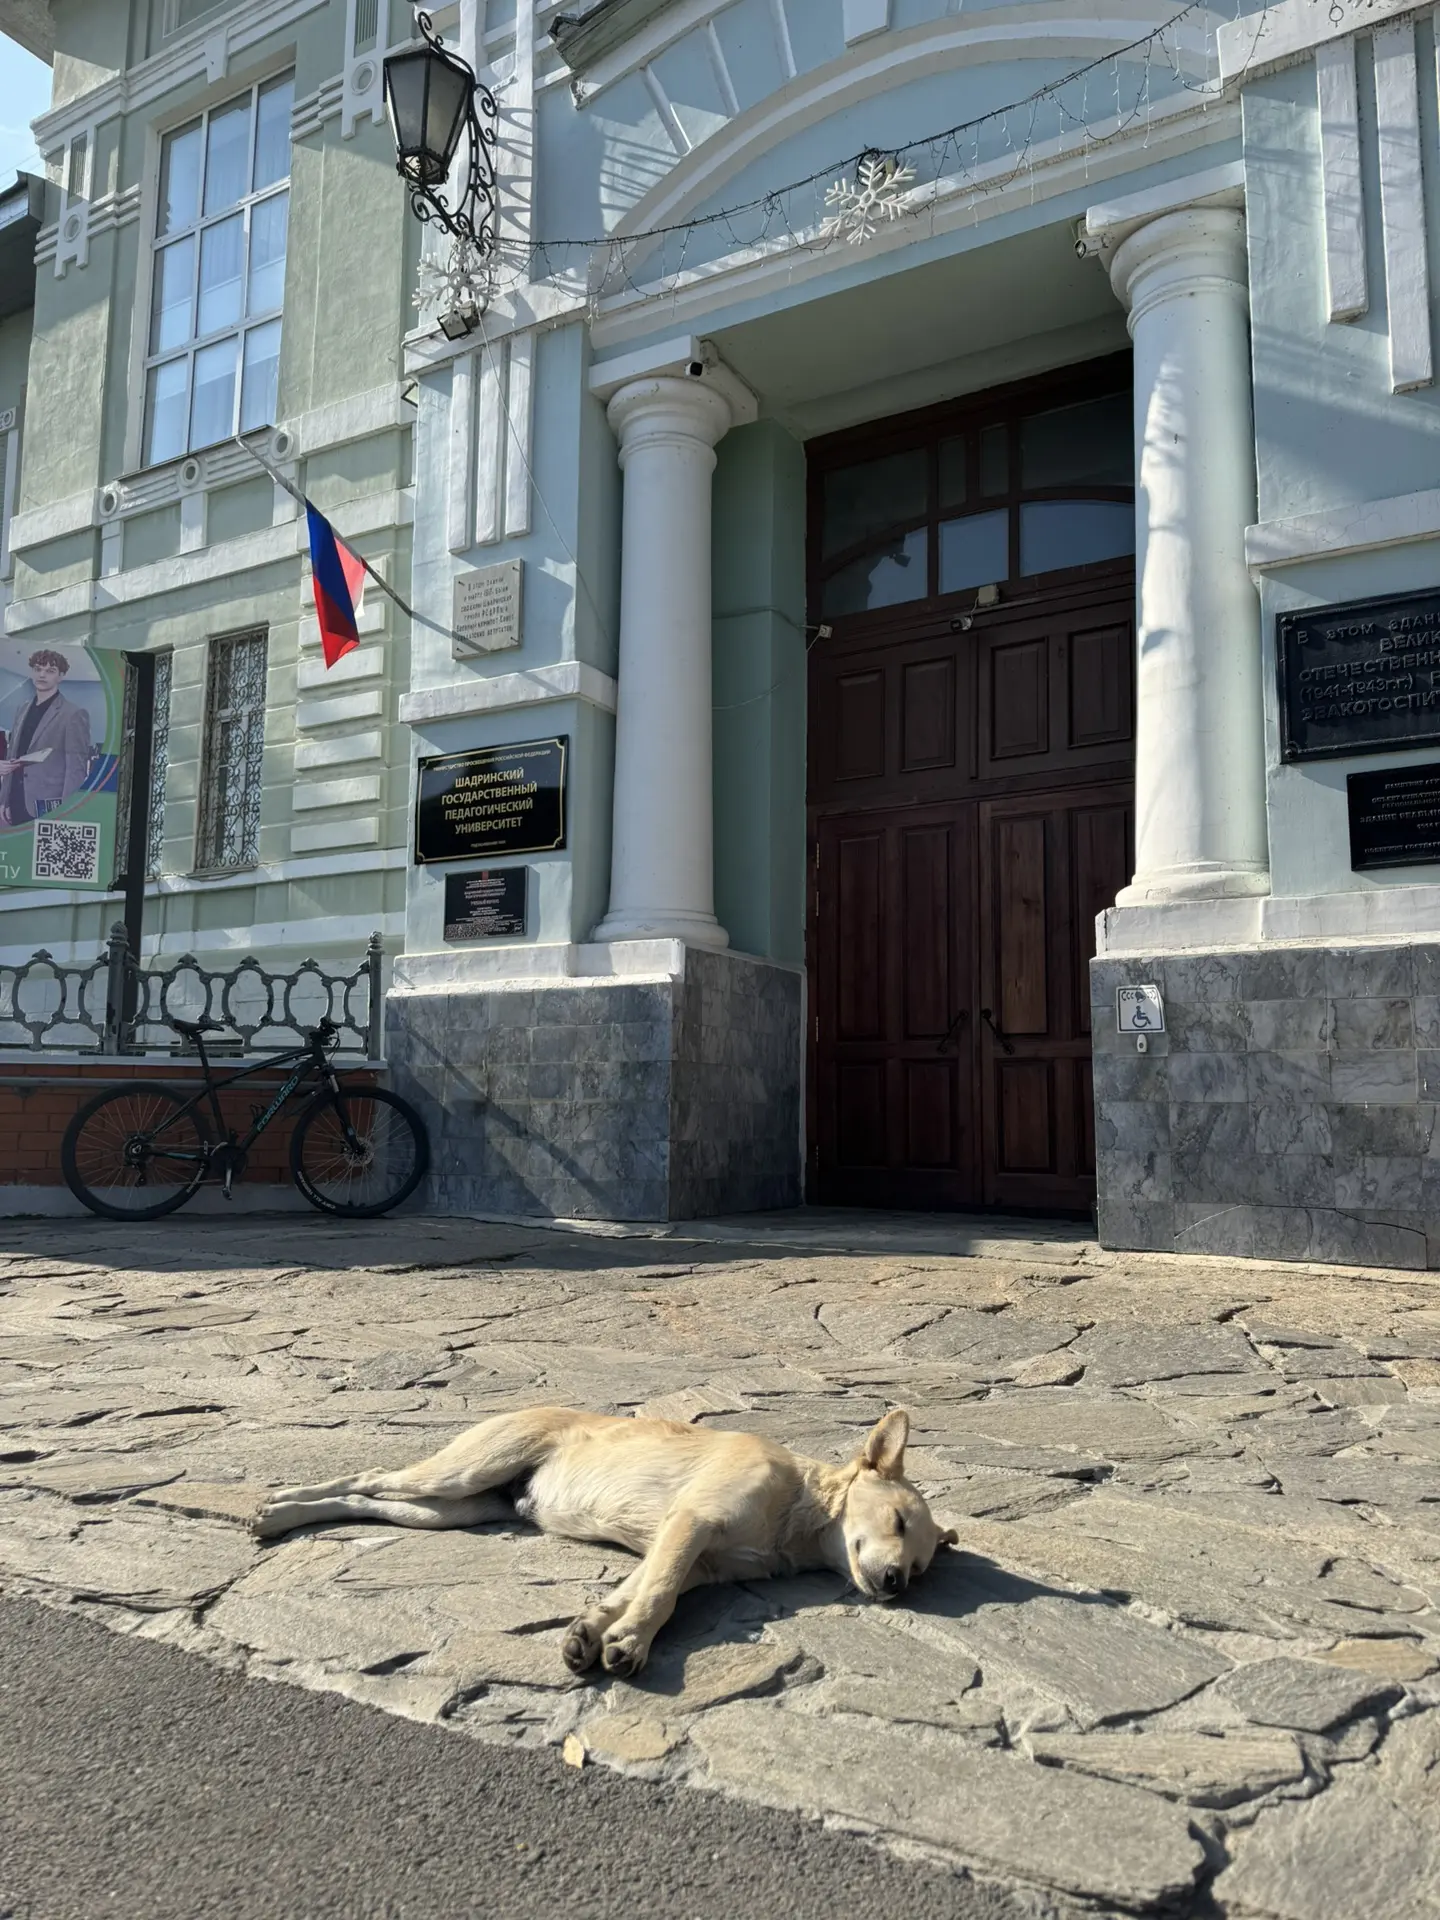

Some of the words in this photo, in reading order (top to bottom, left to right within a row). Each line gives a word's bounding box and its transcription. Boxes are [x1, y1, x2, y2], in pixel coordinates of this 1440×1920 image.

[1297, 630, 1309, 645] В
[1326, 622, 1376, 640] ЭТОМ
[1388, 612, 1440, 631] ЗДАН
[455, 767, 525, 788] ШАДРИНСКИЙ
[441, 781, 538, 806] ГОСУДАРСТВЕННЫЙ
[444, 797, 533, 821] ПЕДАГОГИЧЕСКИЙ
[455, 816, 523, 835] УНИВЕРСИТЕТ
[257, 1075, 299, 1131] FORWARD
